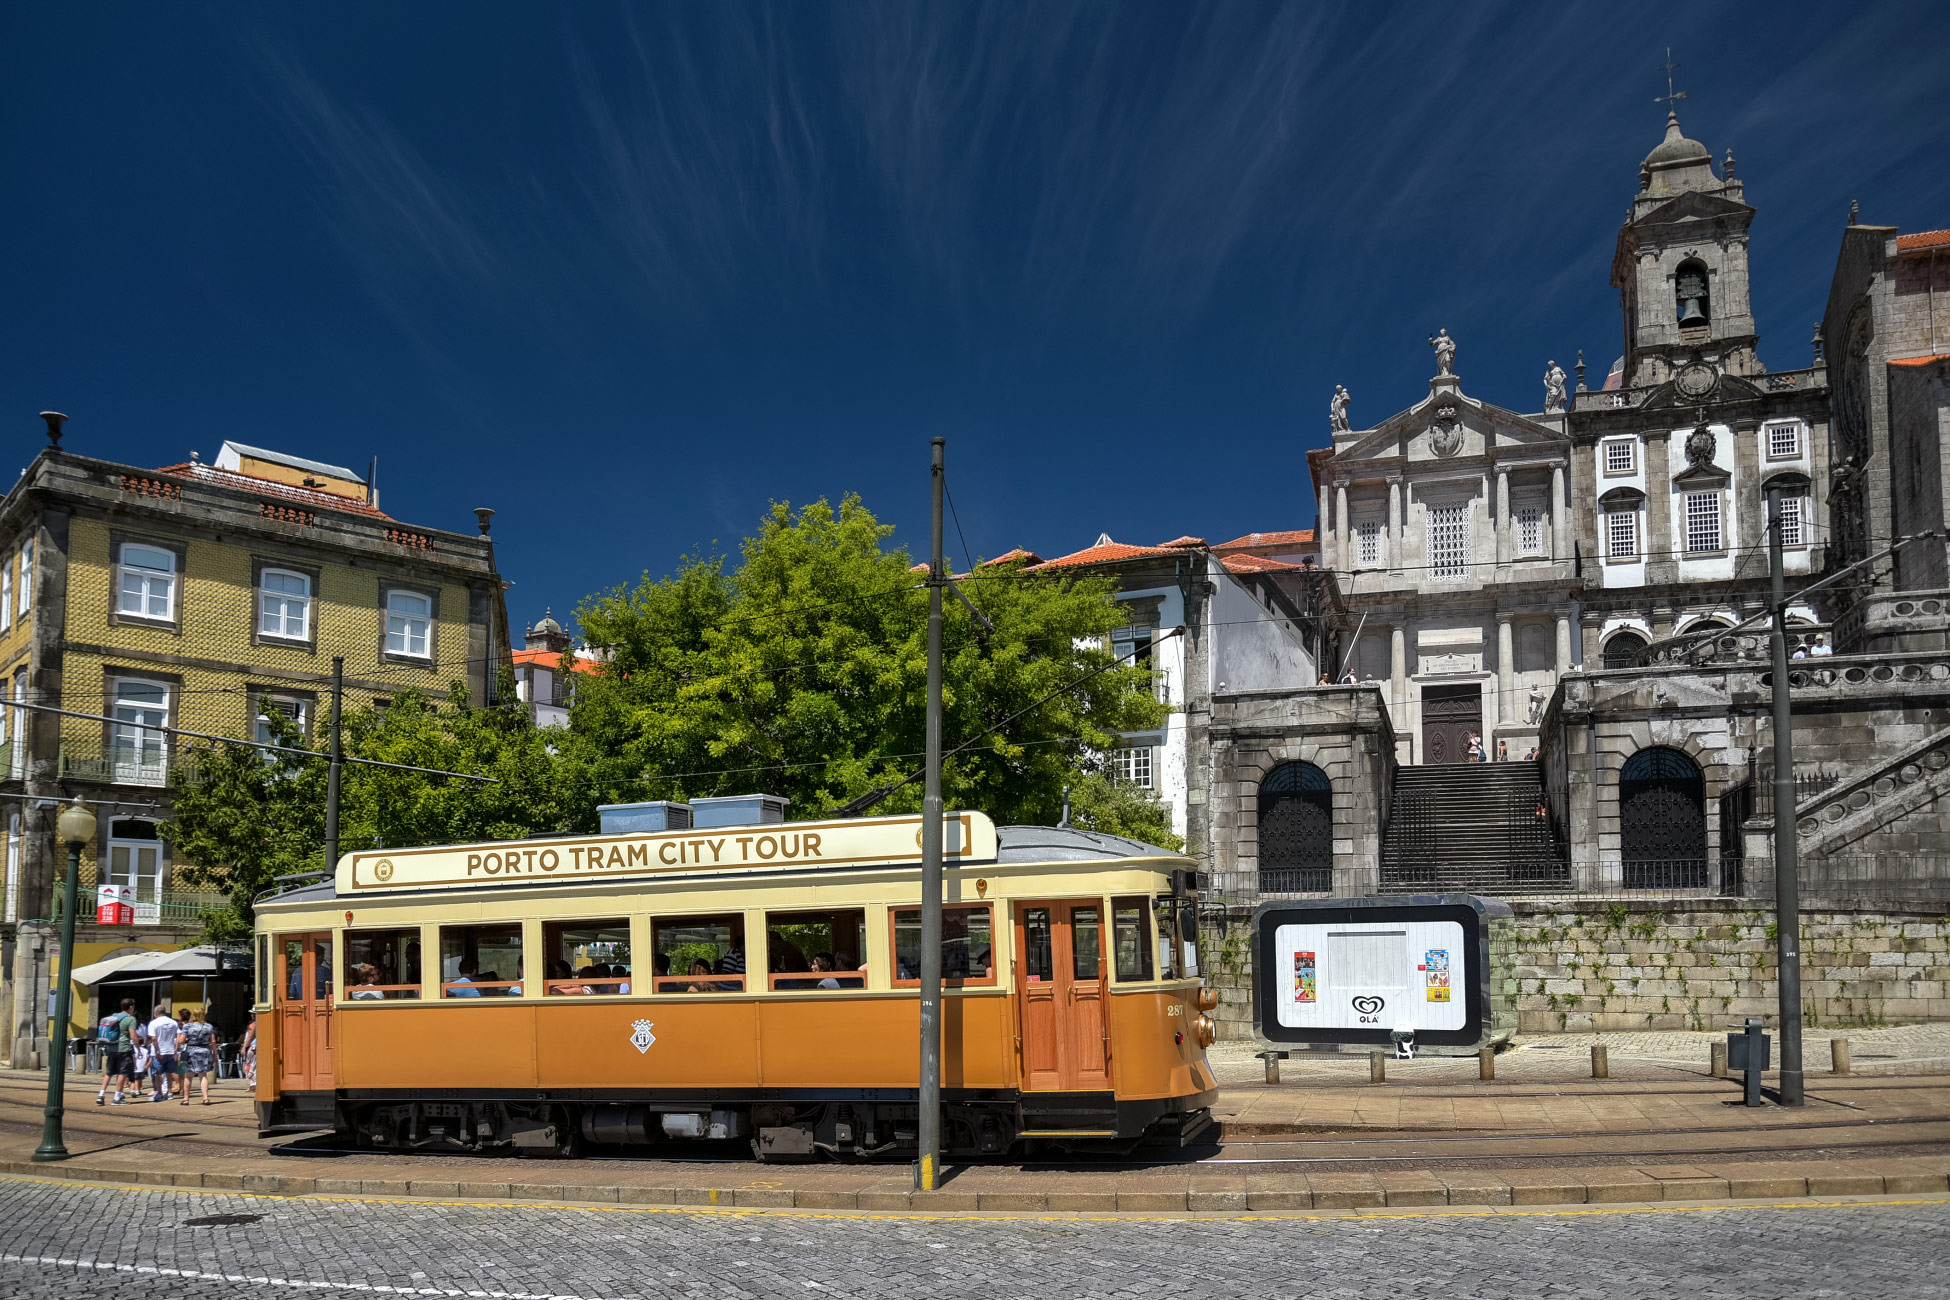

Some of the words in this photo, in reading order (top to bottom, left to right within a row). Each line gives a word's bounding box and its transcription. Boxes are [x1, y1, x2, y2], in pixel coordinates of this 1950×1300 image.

[467, 849, 559, 876] PORTO
[569, 843, 648, 870] TRAM
[659, 838, 726, 866] CITY
[736, 833, 822, 861] TOUR
[1167, 1004, 1183, 1017] 287
[1359, 1014, 1378, 1024] OLÁ
